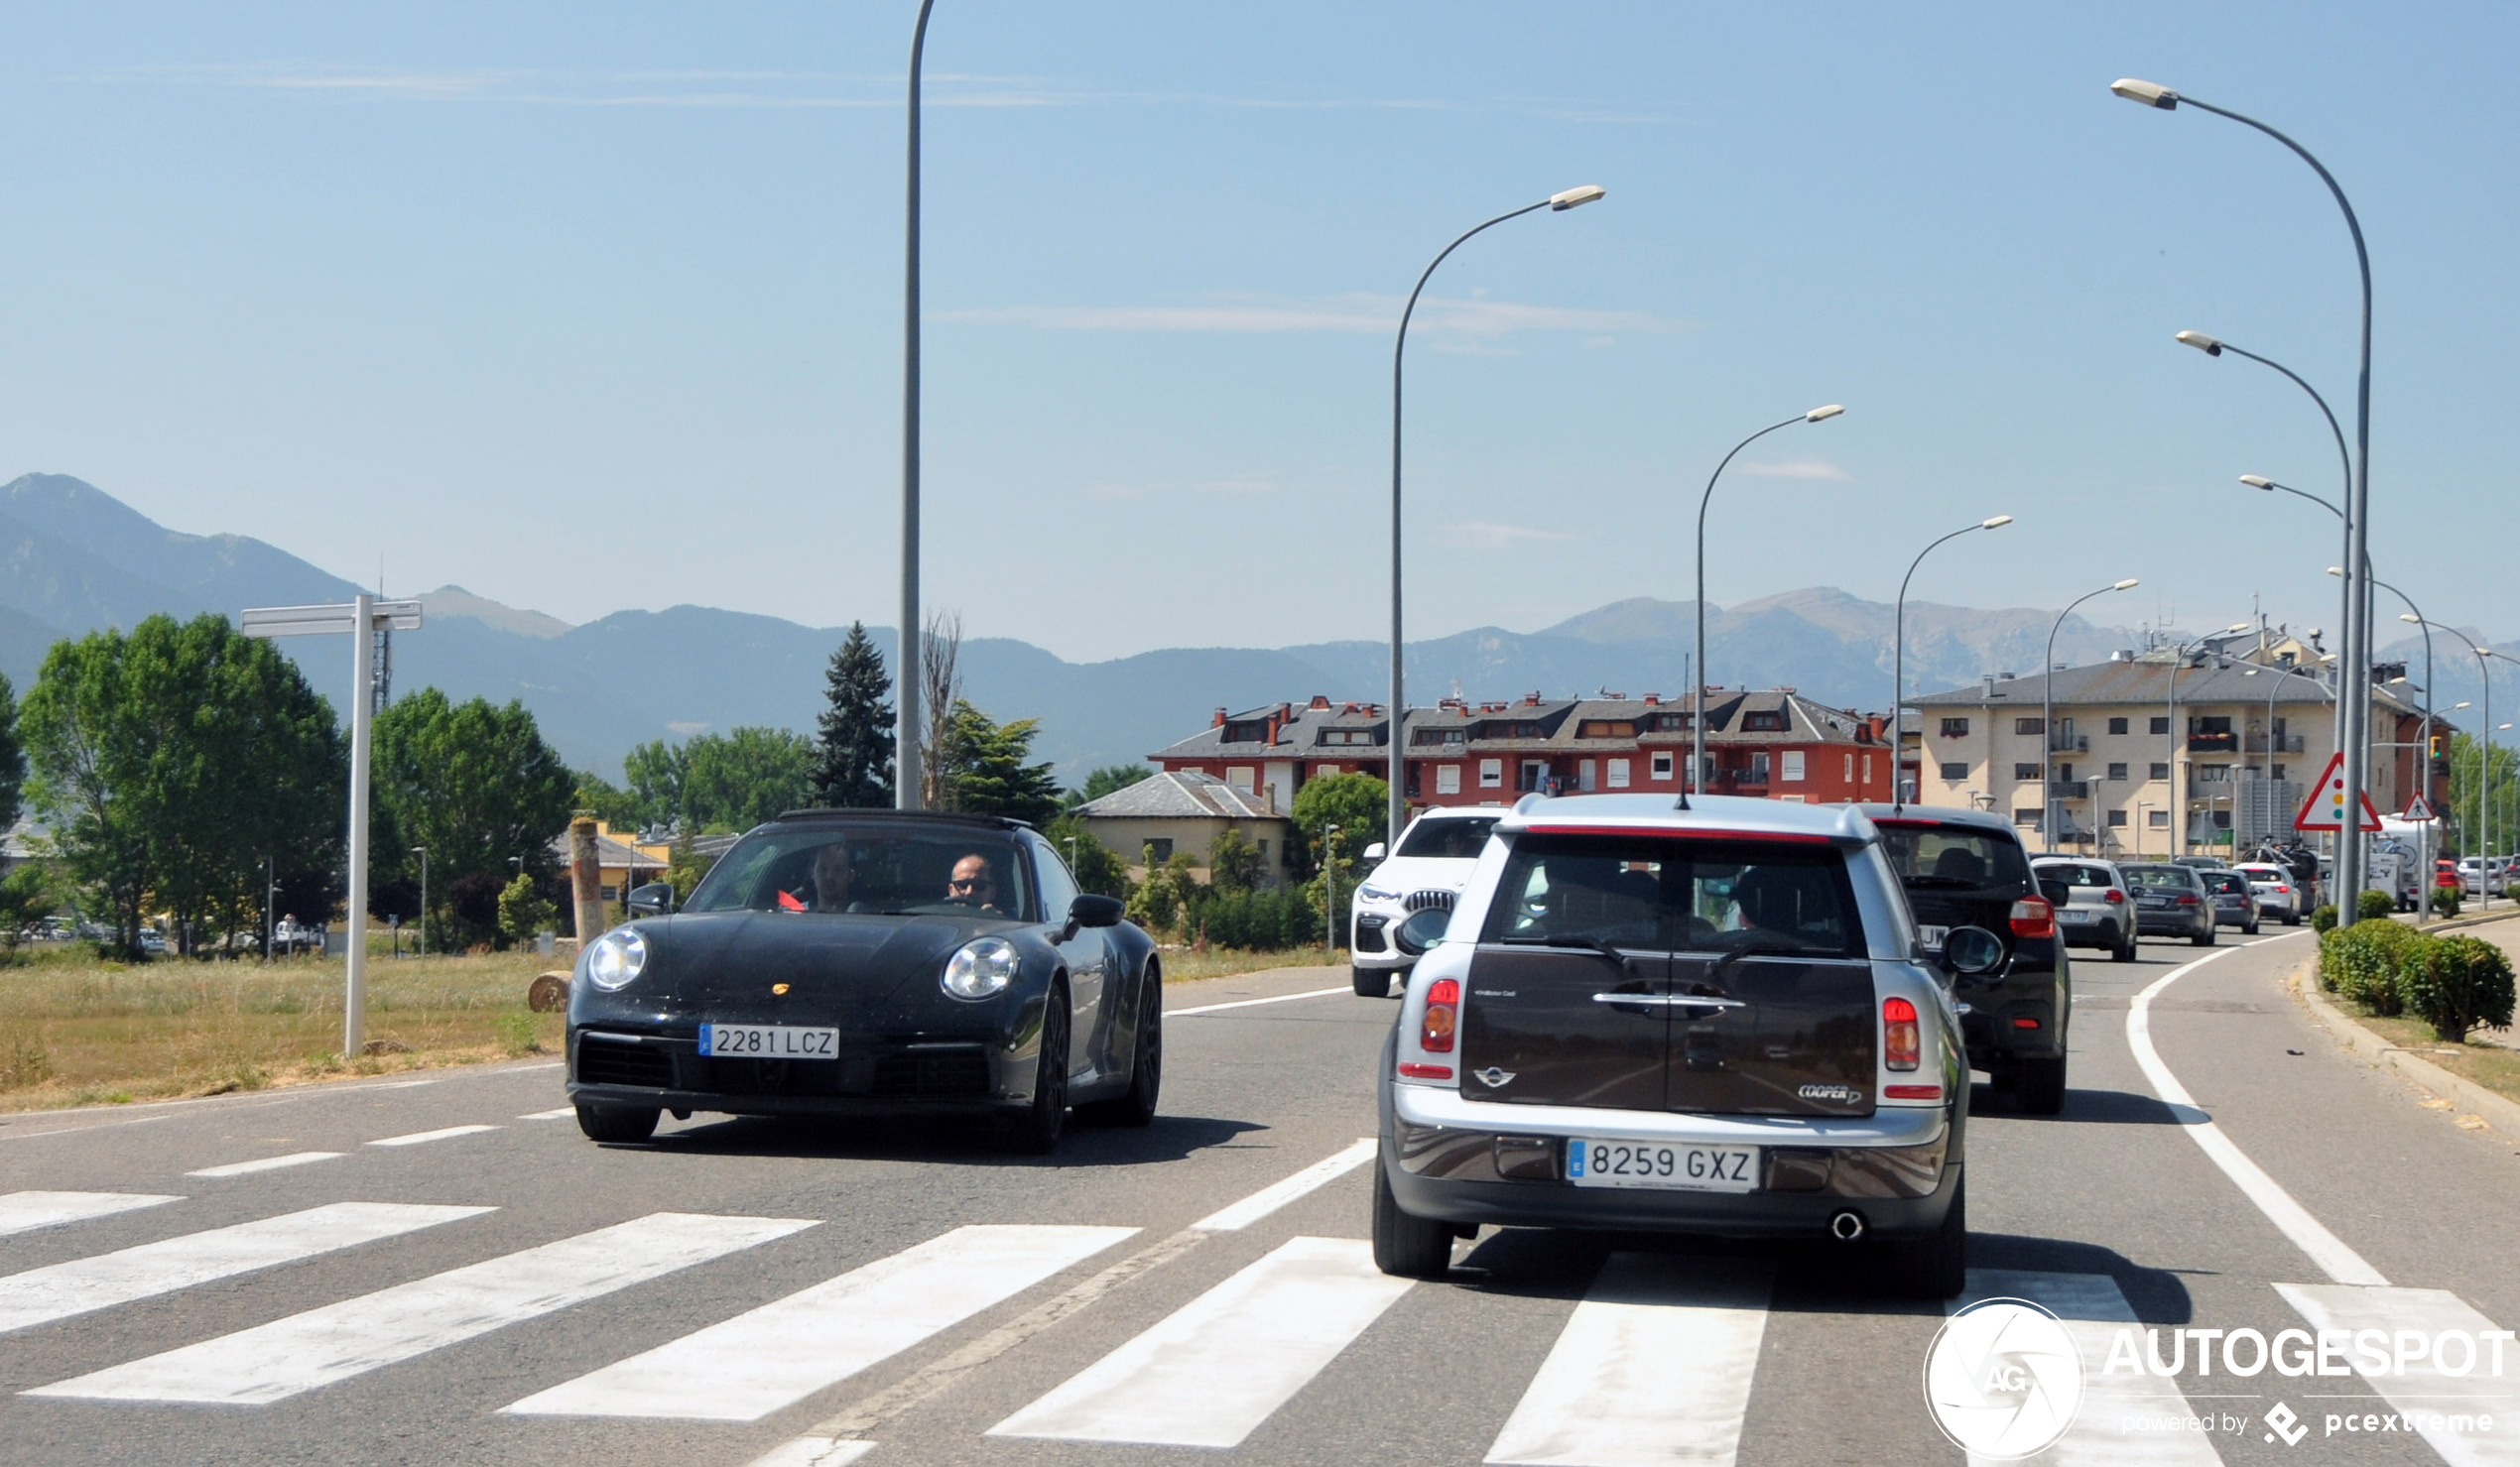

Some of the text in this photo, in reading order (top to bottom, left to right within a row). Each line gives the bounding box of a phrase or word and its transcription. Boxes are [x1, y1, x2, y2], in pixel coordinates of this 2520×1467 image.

[716, 1030, 833, 1054] 2281 LCZ
[1798, 1085, 1849, 1100] COOPER
[1591, 1145, 1675, 1176] 8259
[1688, 1150, 1749, 1181] GXZ
